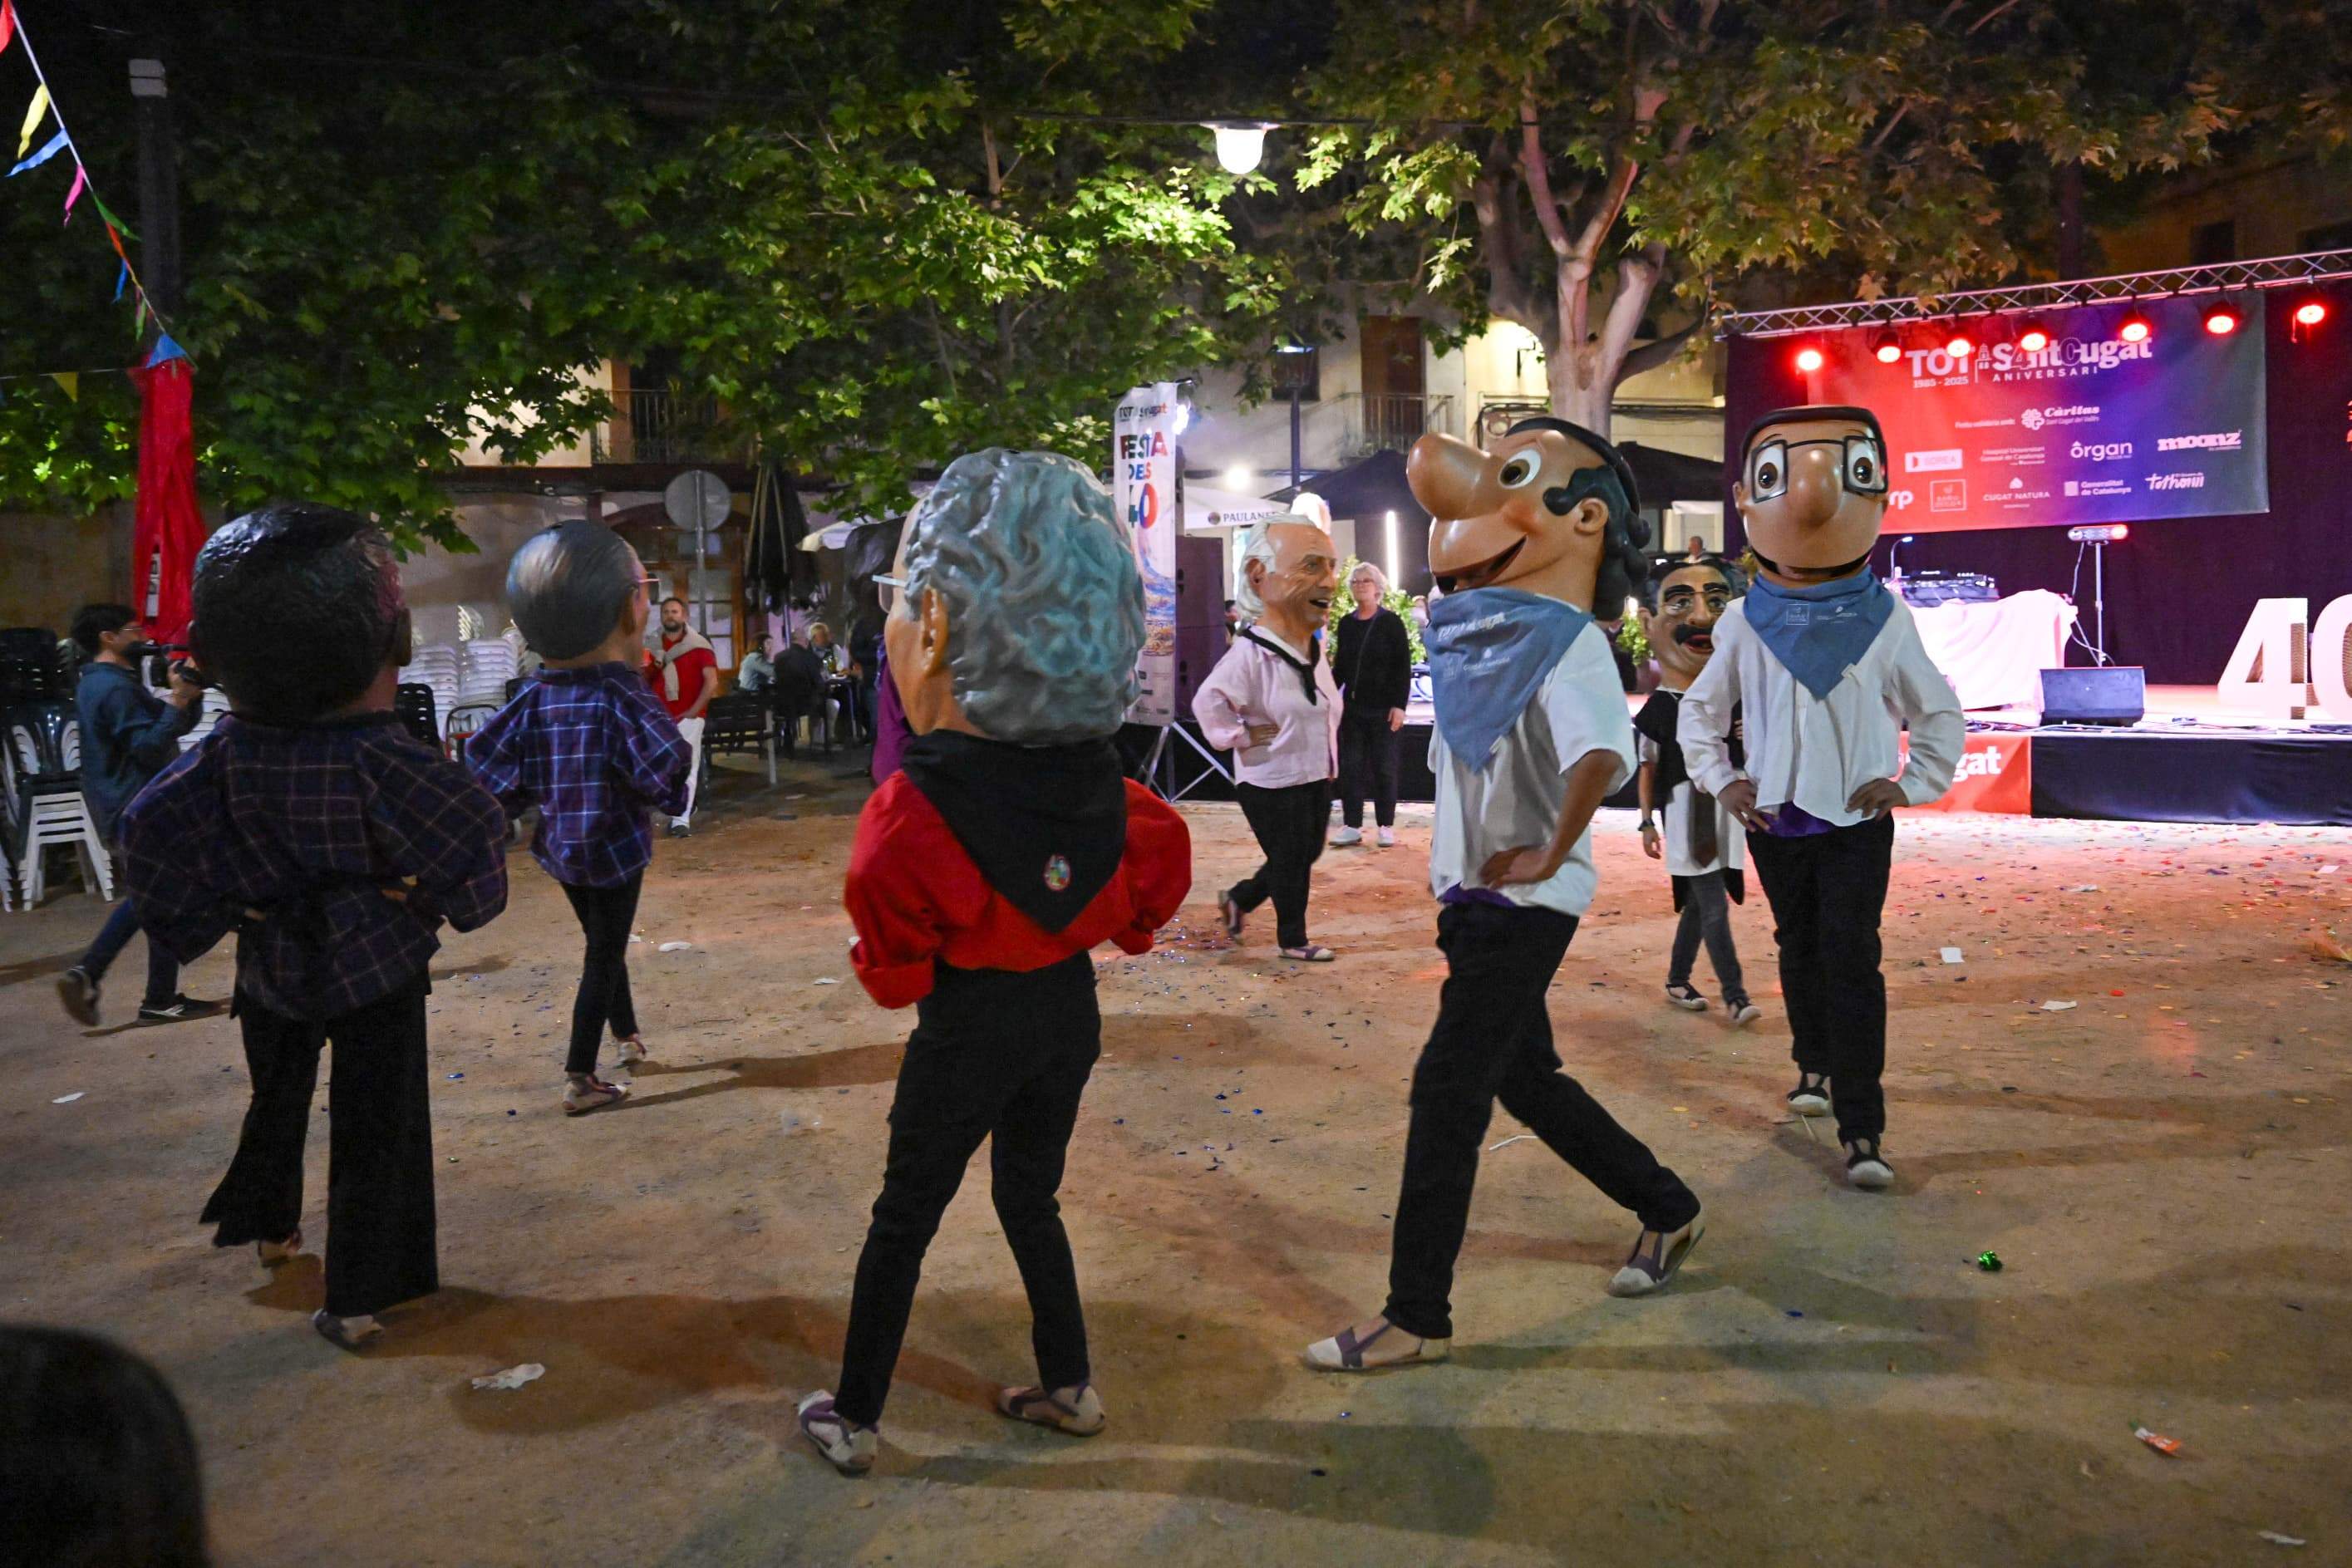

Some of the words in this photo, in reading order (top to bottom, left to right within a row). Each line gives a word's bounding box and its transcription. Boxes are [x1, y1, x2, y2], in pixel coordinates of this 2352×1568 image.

[1905, 346, 1975, 378] TOT
[1993, 366, 2099, 382] ANIVERSARI
[1944, 376, 1969, 386] 2025
[1120, 431, 1168, 460] FESTA
[1983, 493, 2011, 501] CUGAT
[2015, 491, 2050, 499] NATURA
[2093, 487, 2132, 495] Catalunya
